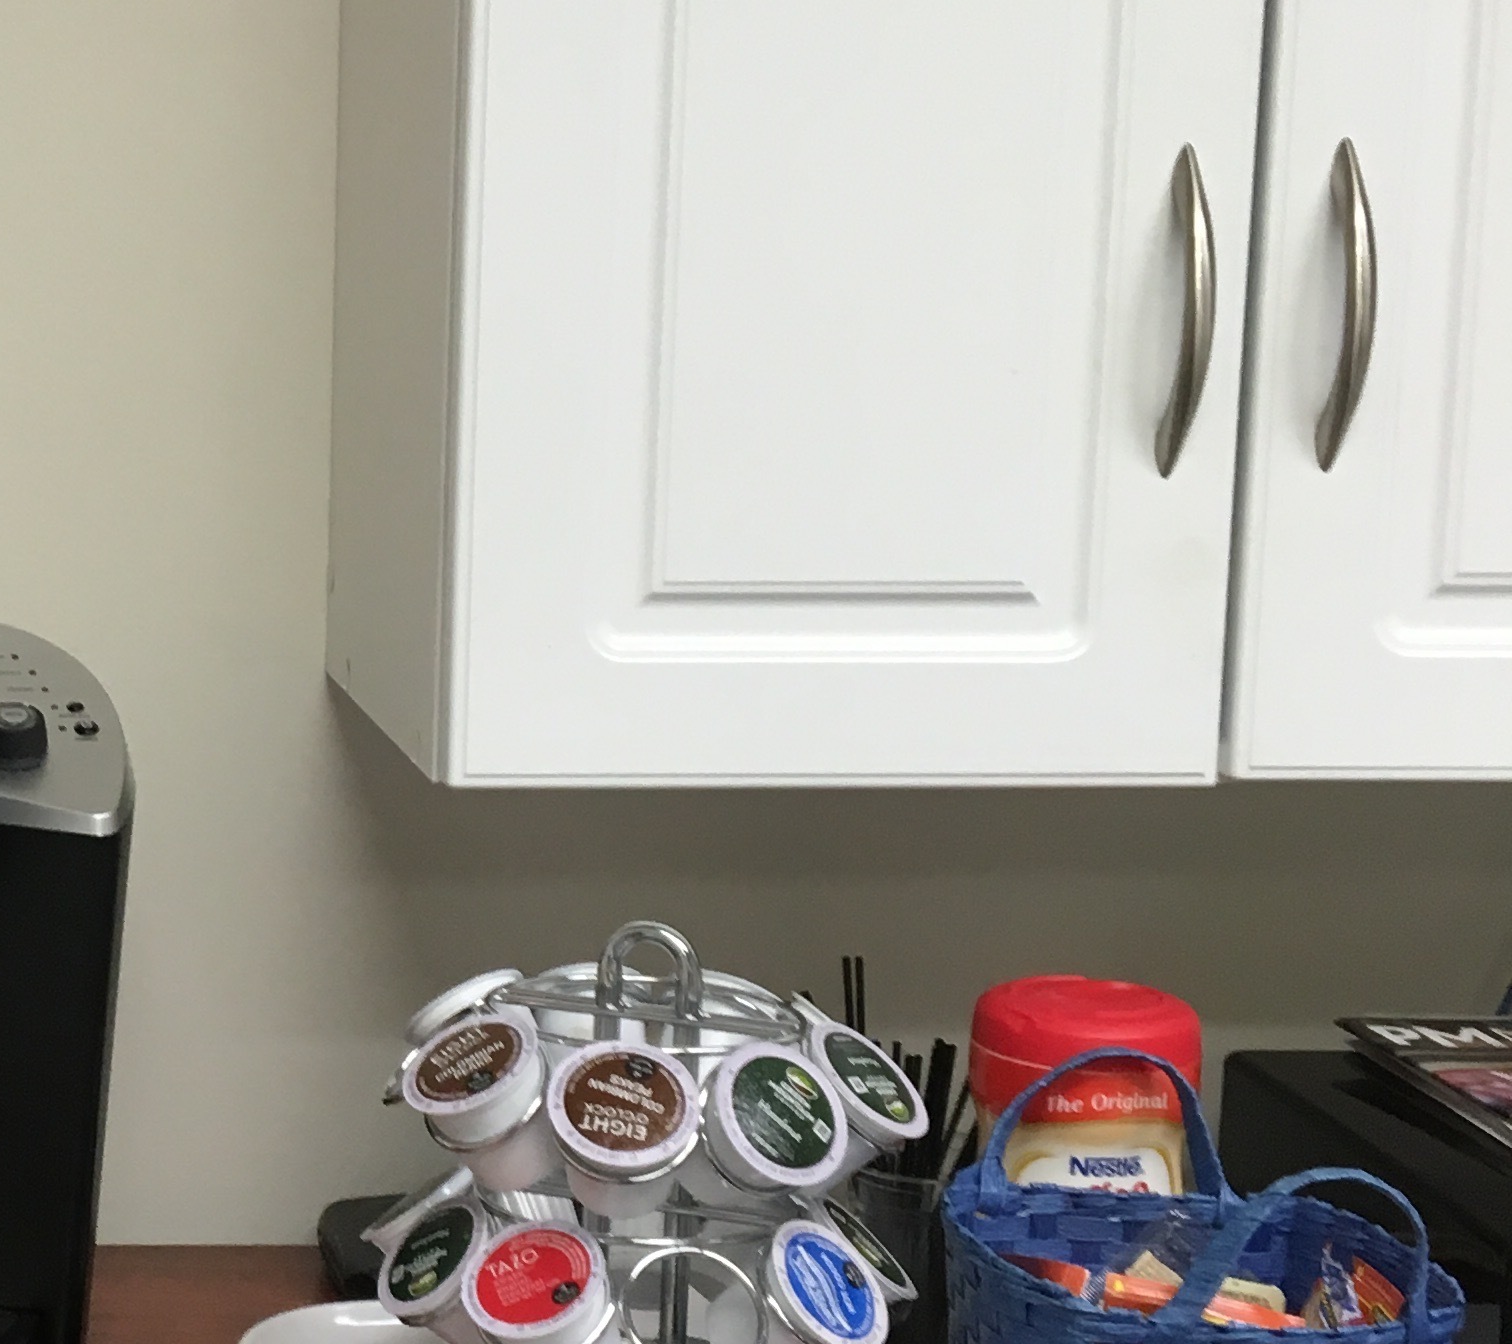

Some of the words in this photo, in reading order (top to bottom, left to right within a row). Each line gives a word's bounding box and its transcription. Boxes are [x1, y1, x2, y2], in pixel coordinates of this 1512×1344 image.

[1047, 1093, 1085, 1113] The
[1090, 1091, 1169, 1114] Original
[578, 1114, 647, 1141] EIGHT
